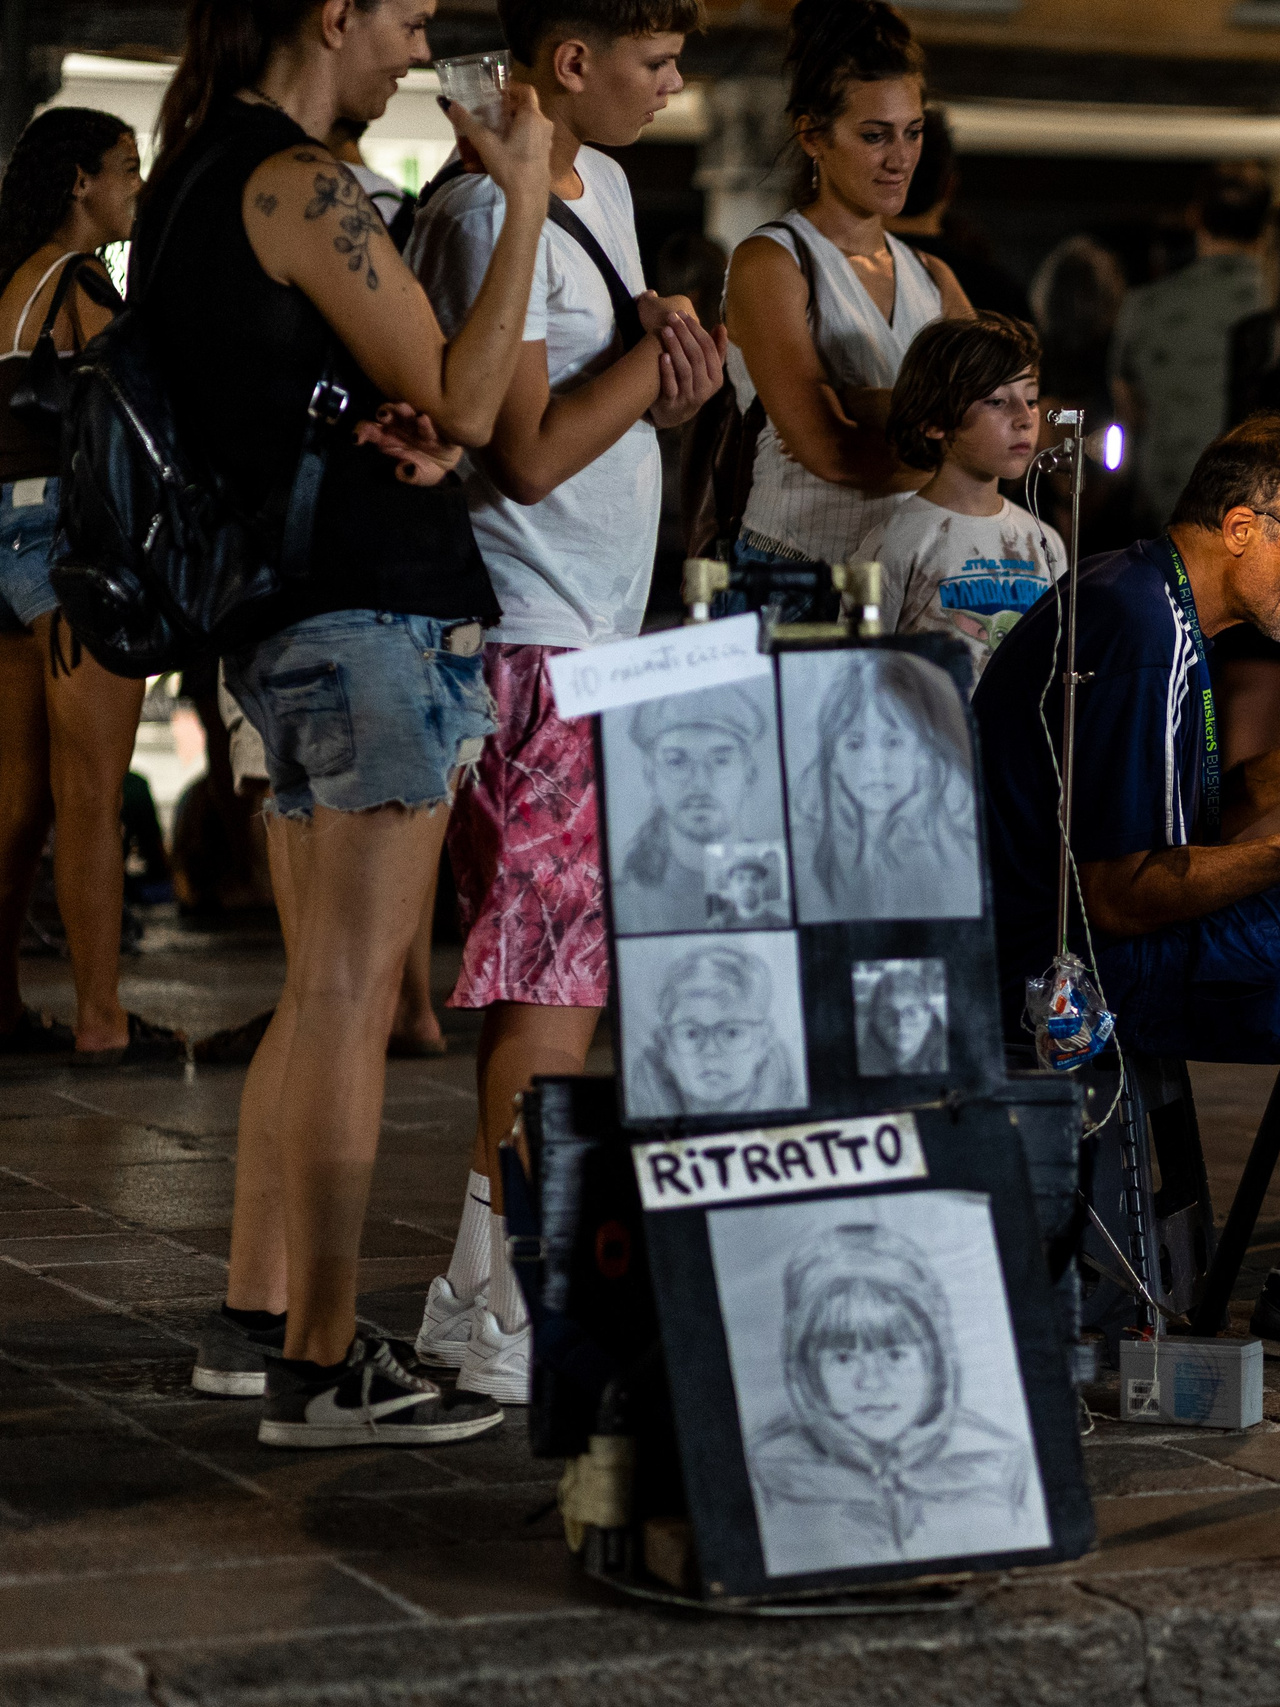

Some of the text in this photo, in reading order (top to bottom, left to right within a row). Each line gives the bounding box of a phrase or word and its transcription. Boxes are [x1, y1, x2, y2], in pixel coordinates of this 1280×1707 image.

[961, 558, 1035, 571] STAR WARS
[939, 578, 1050, 608] MANDALORI
[1202, 688, 1217, 752] BuskerS
[1206, 754, 1220, 826] BUSKERS
